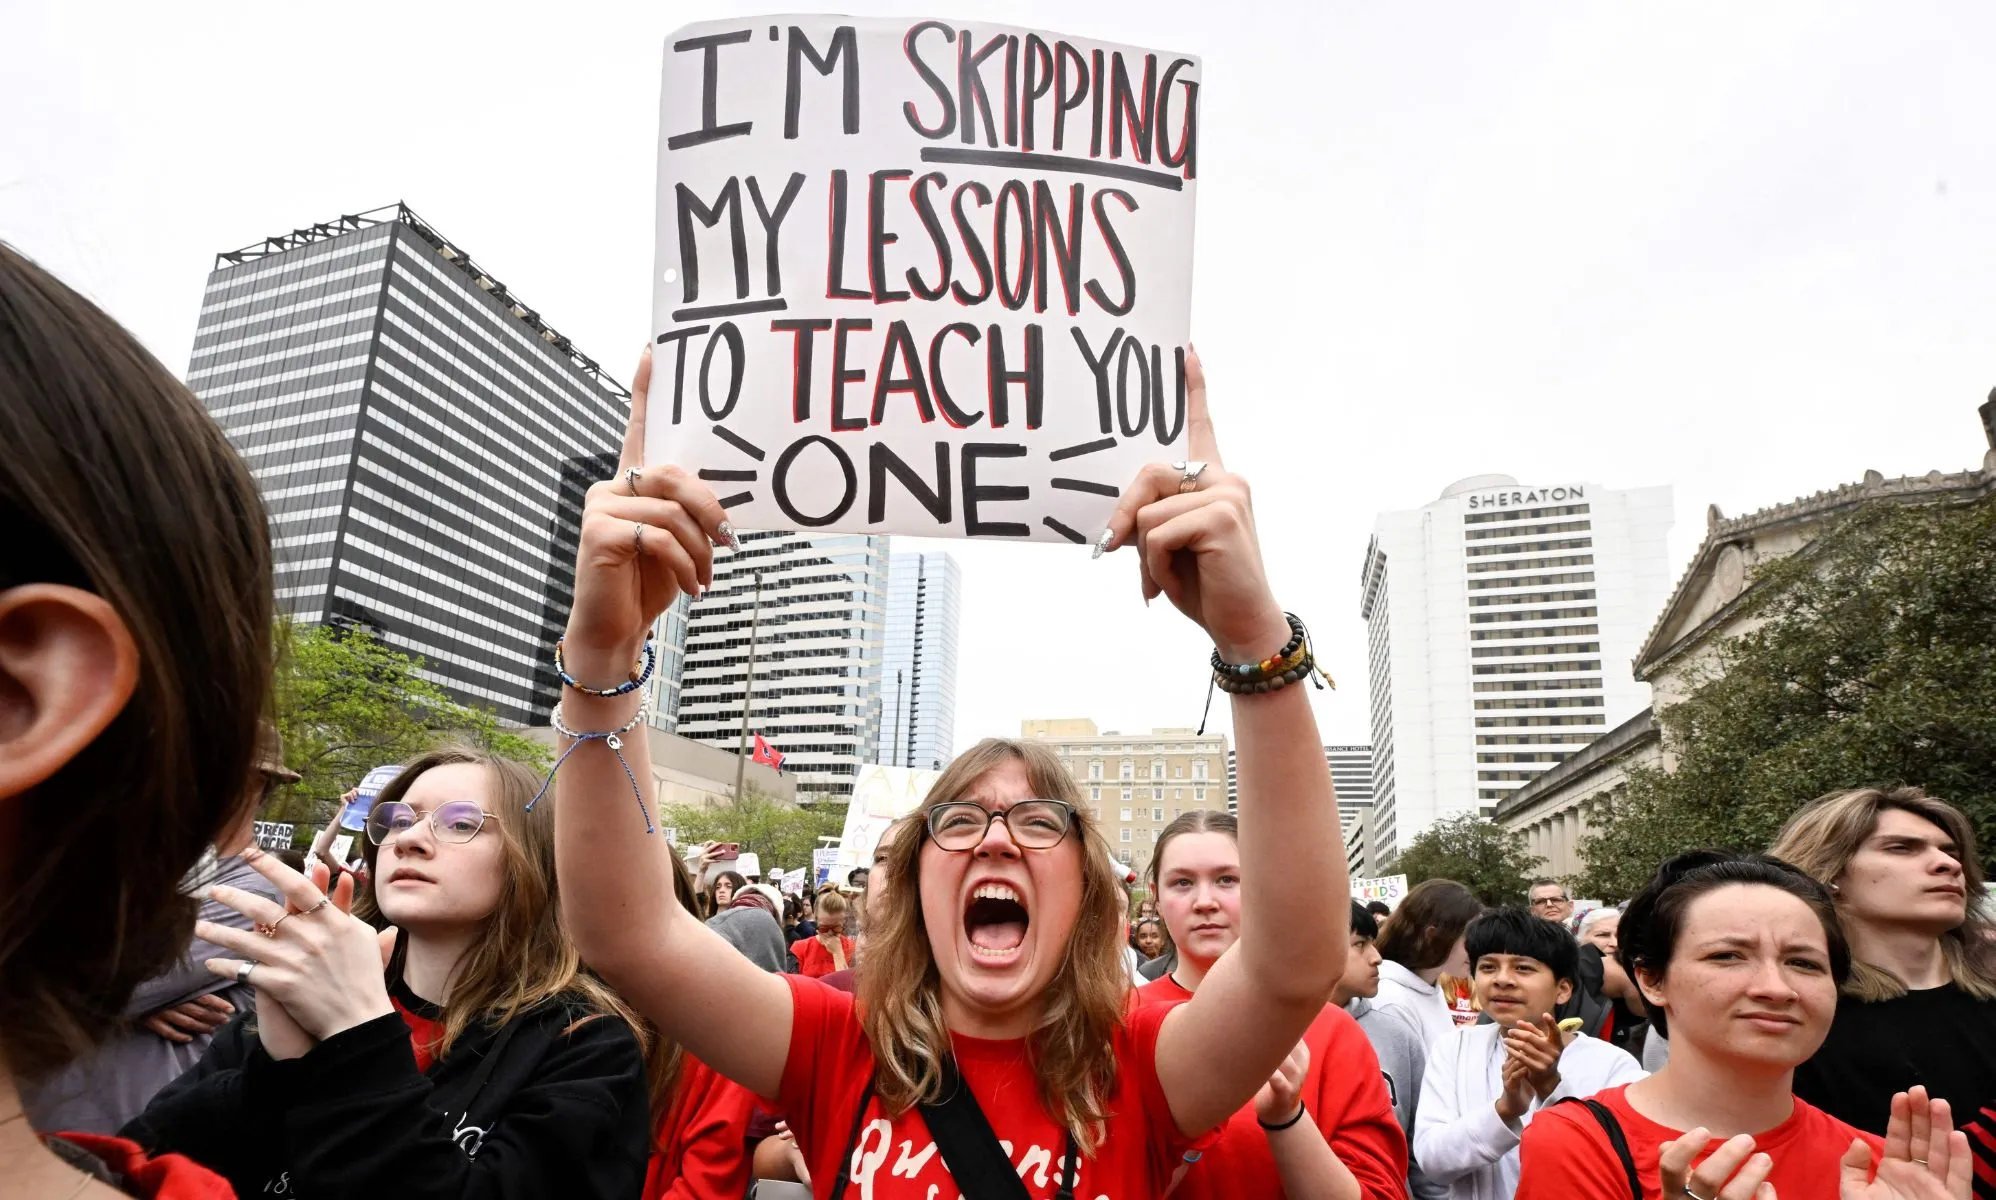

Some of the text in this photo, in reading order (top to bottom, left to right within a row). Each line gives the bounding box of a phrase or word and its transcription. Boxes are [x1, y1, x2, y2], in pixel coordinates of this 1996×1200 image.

[668, 21, 1199, 180] I'M SKIPPING
[675, 169, 1138, 317] MY LESSONS
[657, 318, 1186, 445] TO TEACH YOU
[772, 435, 1030, 536] ONE
[1469, 486, 1584, 509] SHERATON
[263, 824, 292, 837] READ
[1363, 885, 1398, 898] KIDS
